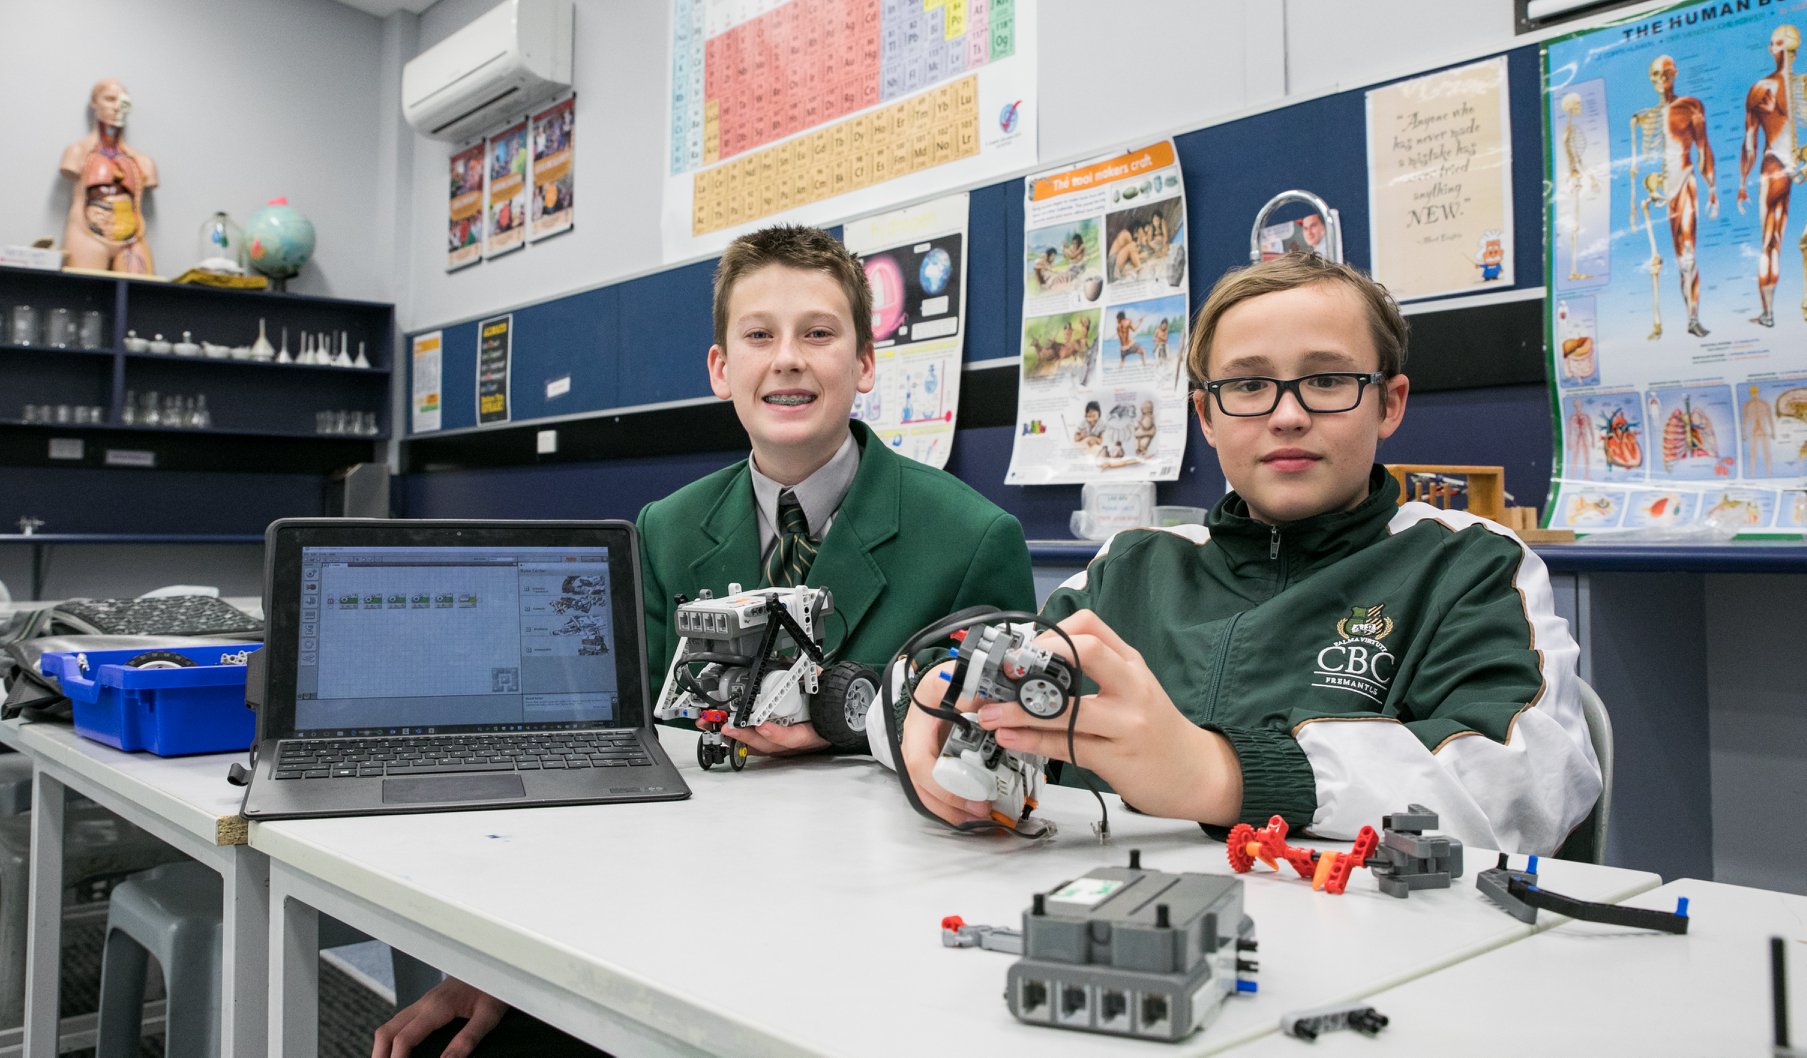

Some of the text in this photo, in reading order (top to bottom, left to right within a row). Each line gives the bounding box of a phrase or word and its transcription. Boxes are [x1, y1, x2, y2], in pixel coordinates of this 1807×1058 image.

[1623, 21, 1663, 40] THE
[1669, 0, 1750, 29] HUMAN
[960, 94, 972, 106] Lu
[1452, 102, 1474, 117] who
[936, 139, 950, 151] No
[961, 133, 973, 146] Lr
[1393, 118, 1480, 151] has never made
[1408, 143, 1452, 168] mistake
[1456, 138, 1477, 156] has
[1053, 154, 1152, 191] The tool makers craft
[1413, 182, 1462, 205] anything
[1333, 637, 1360, 648] PALMA
[1317, 646, 1396, 685] CBC
